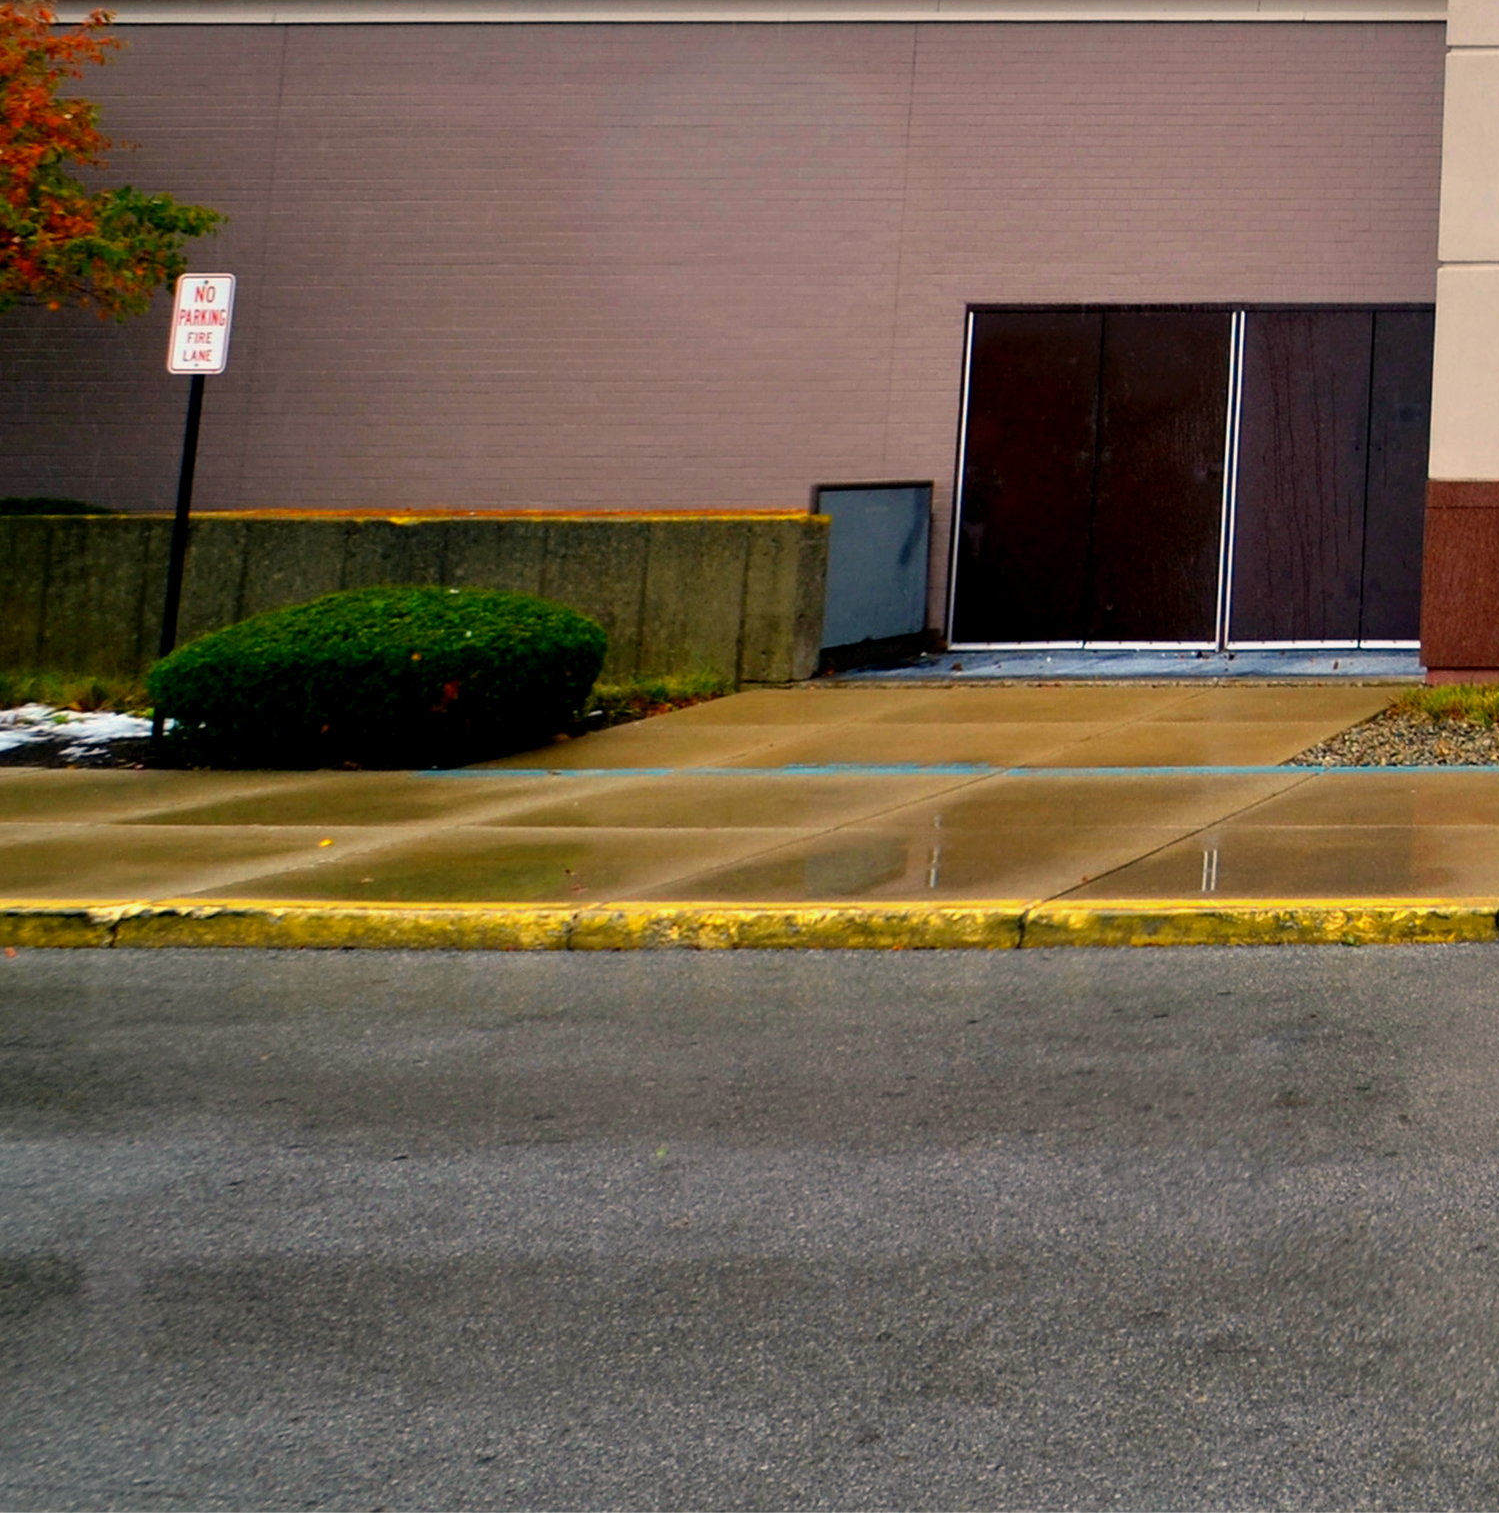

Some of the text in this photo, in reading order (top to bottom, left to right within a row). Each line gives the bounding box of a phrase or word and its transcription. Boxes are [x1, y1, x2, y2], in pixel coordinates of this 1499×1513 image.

[194, 286, 216, 303] NO
[179, 308, 226, 326] PARKING
[187, 331, 213, 344] FIRE
[182, 349, 213, 362] LANE
